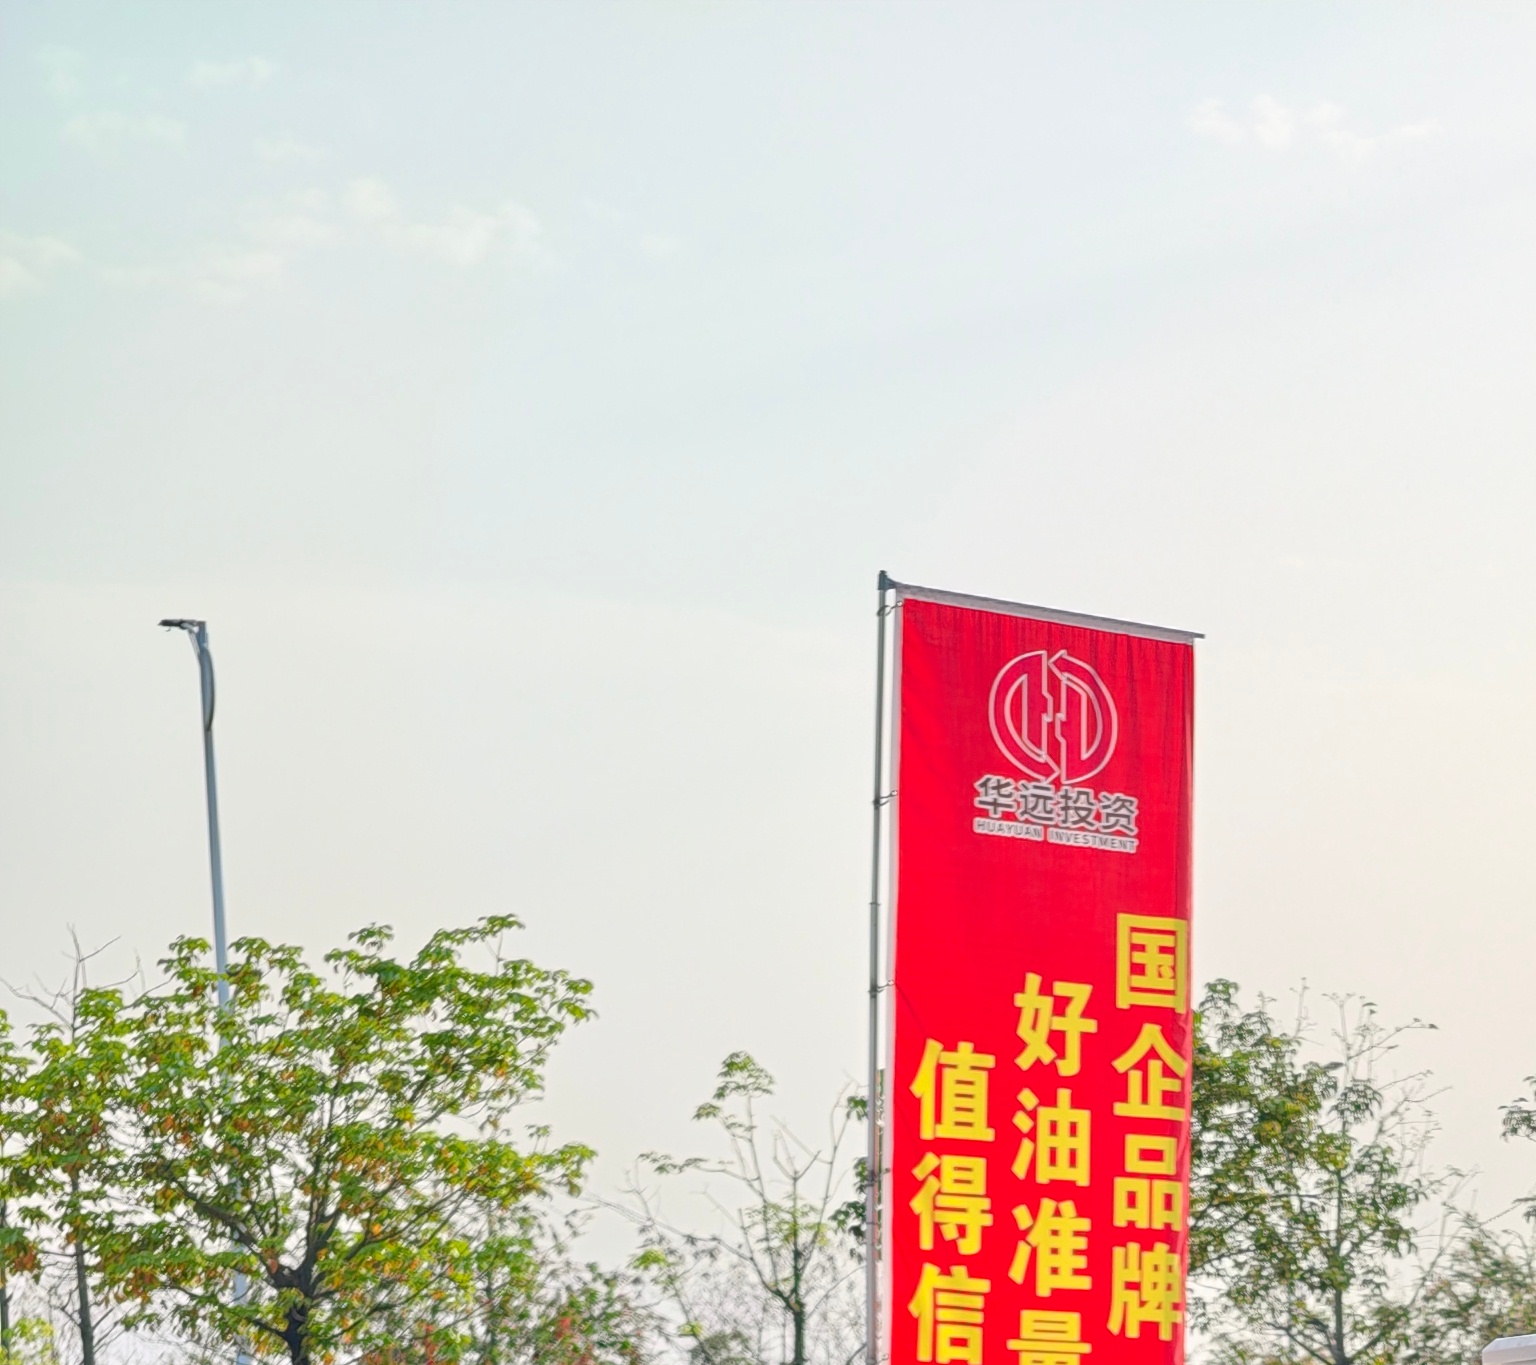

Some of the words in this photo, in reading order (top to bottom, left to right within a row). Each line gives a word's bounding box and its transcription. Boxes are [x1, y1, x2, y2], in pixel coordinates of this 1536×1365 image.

[977, 776, 1135, 834] 华远投资
[975, 819, 1043, 839] HUAYUAN
[1049, 831, 1137, 851] INVESTMENT
[1106, 912, 1189, 1342] 国企品牌
